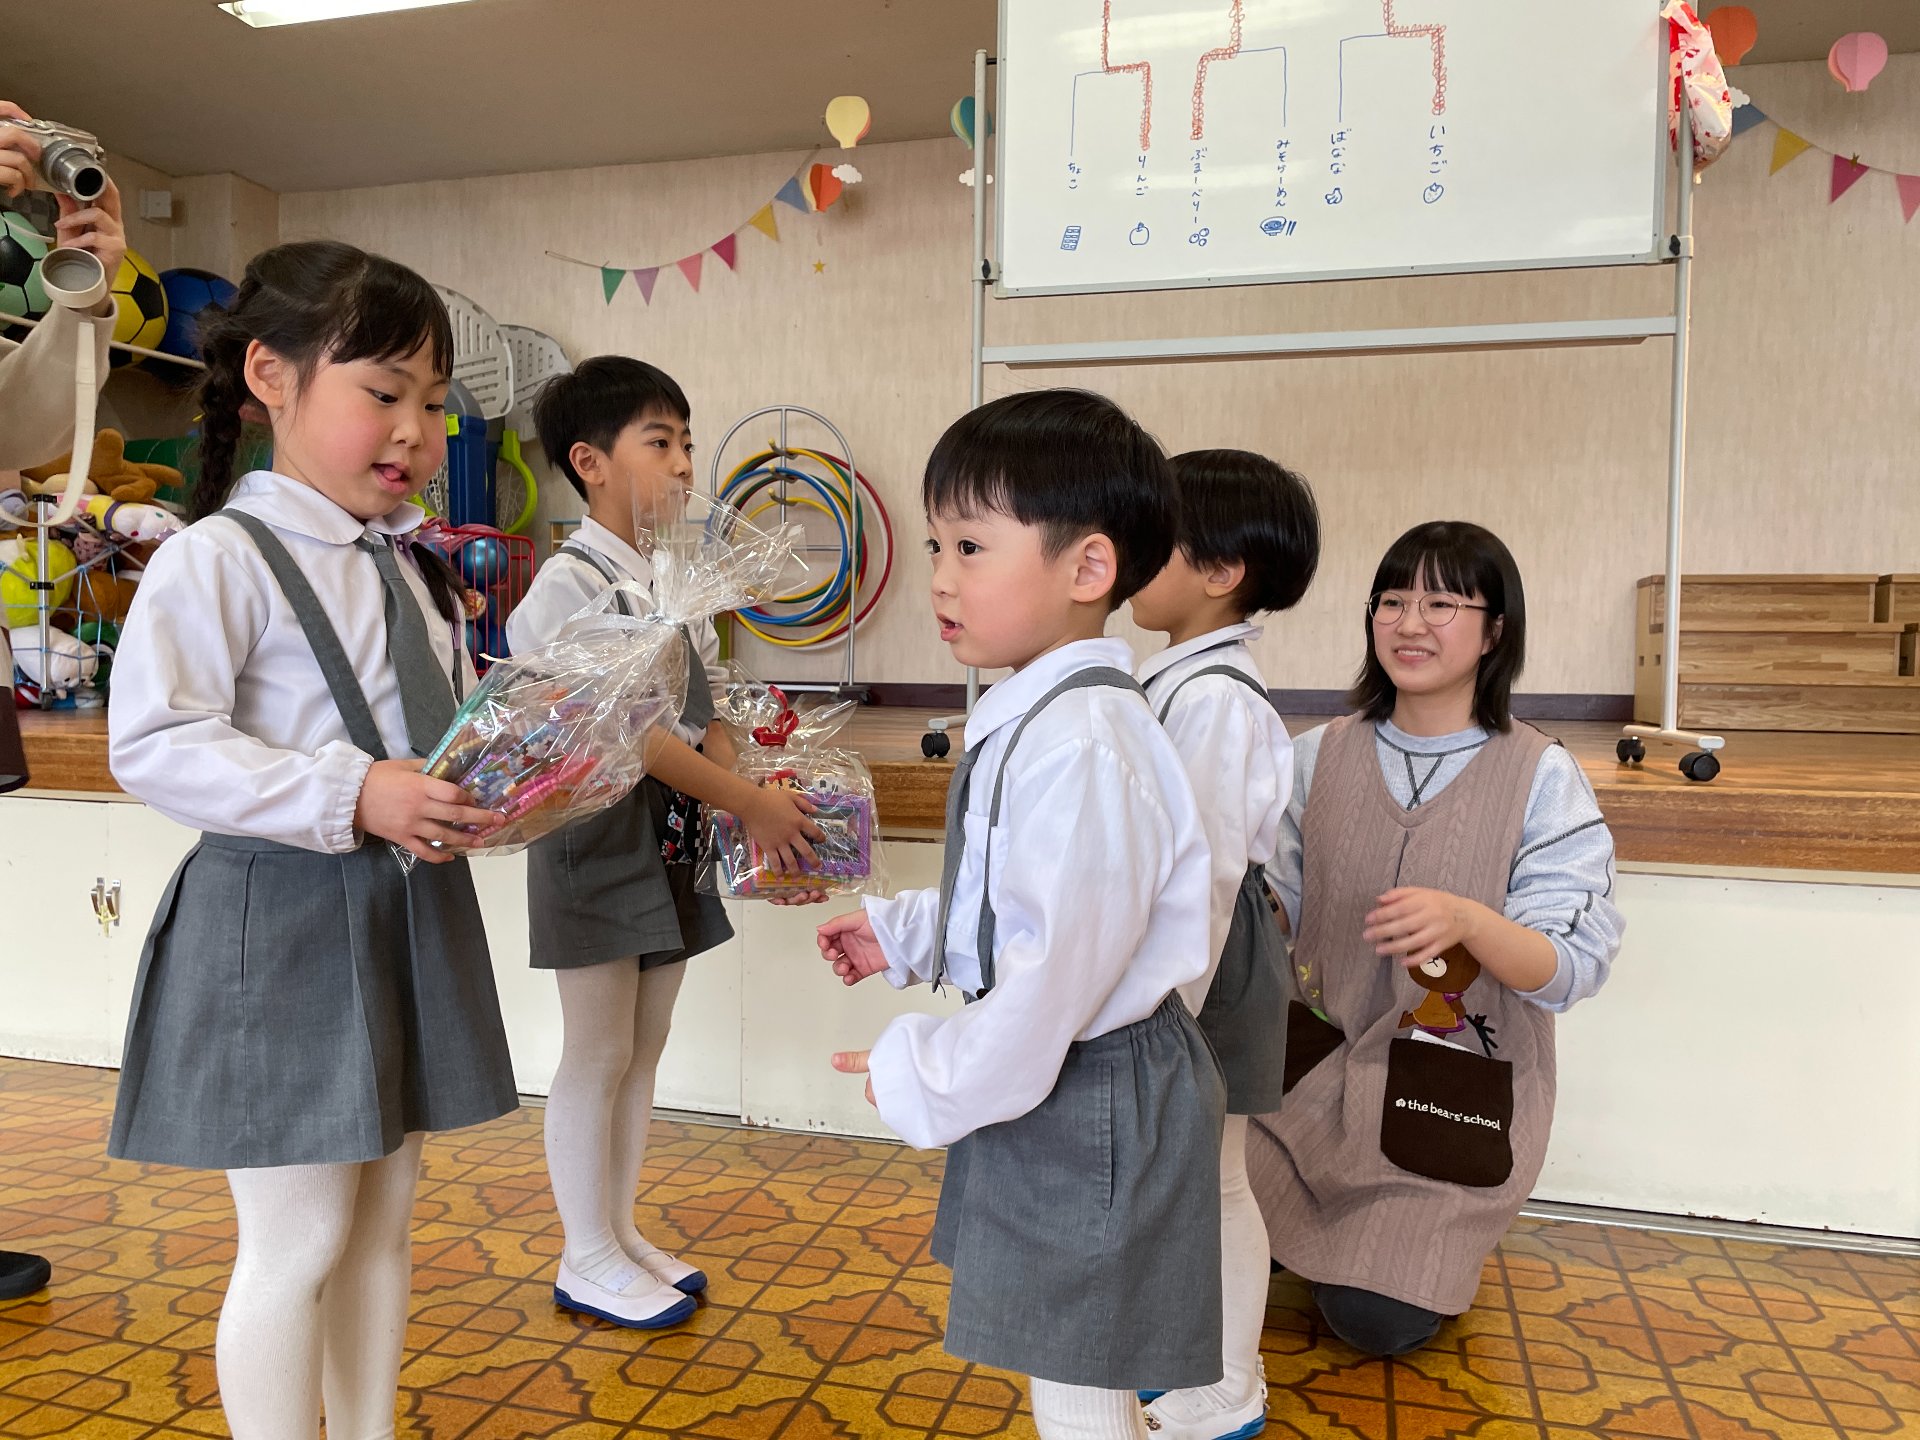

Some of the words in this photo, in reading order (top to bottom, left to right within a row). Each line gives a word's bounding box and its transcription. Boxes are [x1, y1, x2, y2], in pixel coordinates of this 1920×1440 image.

[1330, 128, 1352, 174] ばなな
[1429, 125, 1448, 173] いちご
[1067, 162, 1082, 189] ちょこ
[1136, 155, 1149, 196] りんご
[1190, 147, 1208, 224] ぶるーべりー
[1275, 139, 1290, 207] みそらーめん
[1408, 1099, 1429, 1112] the
[1430, 1102, 1463, 1122] bears'
[1463, 1114, 1501, 1131] school
